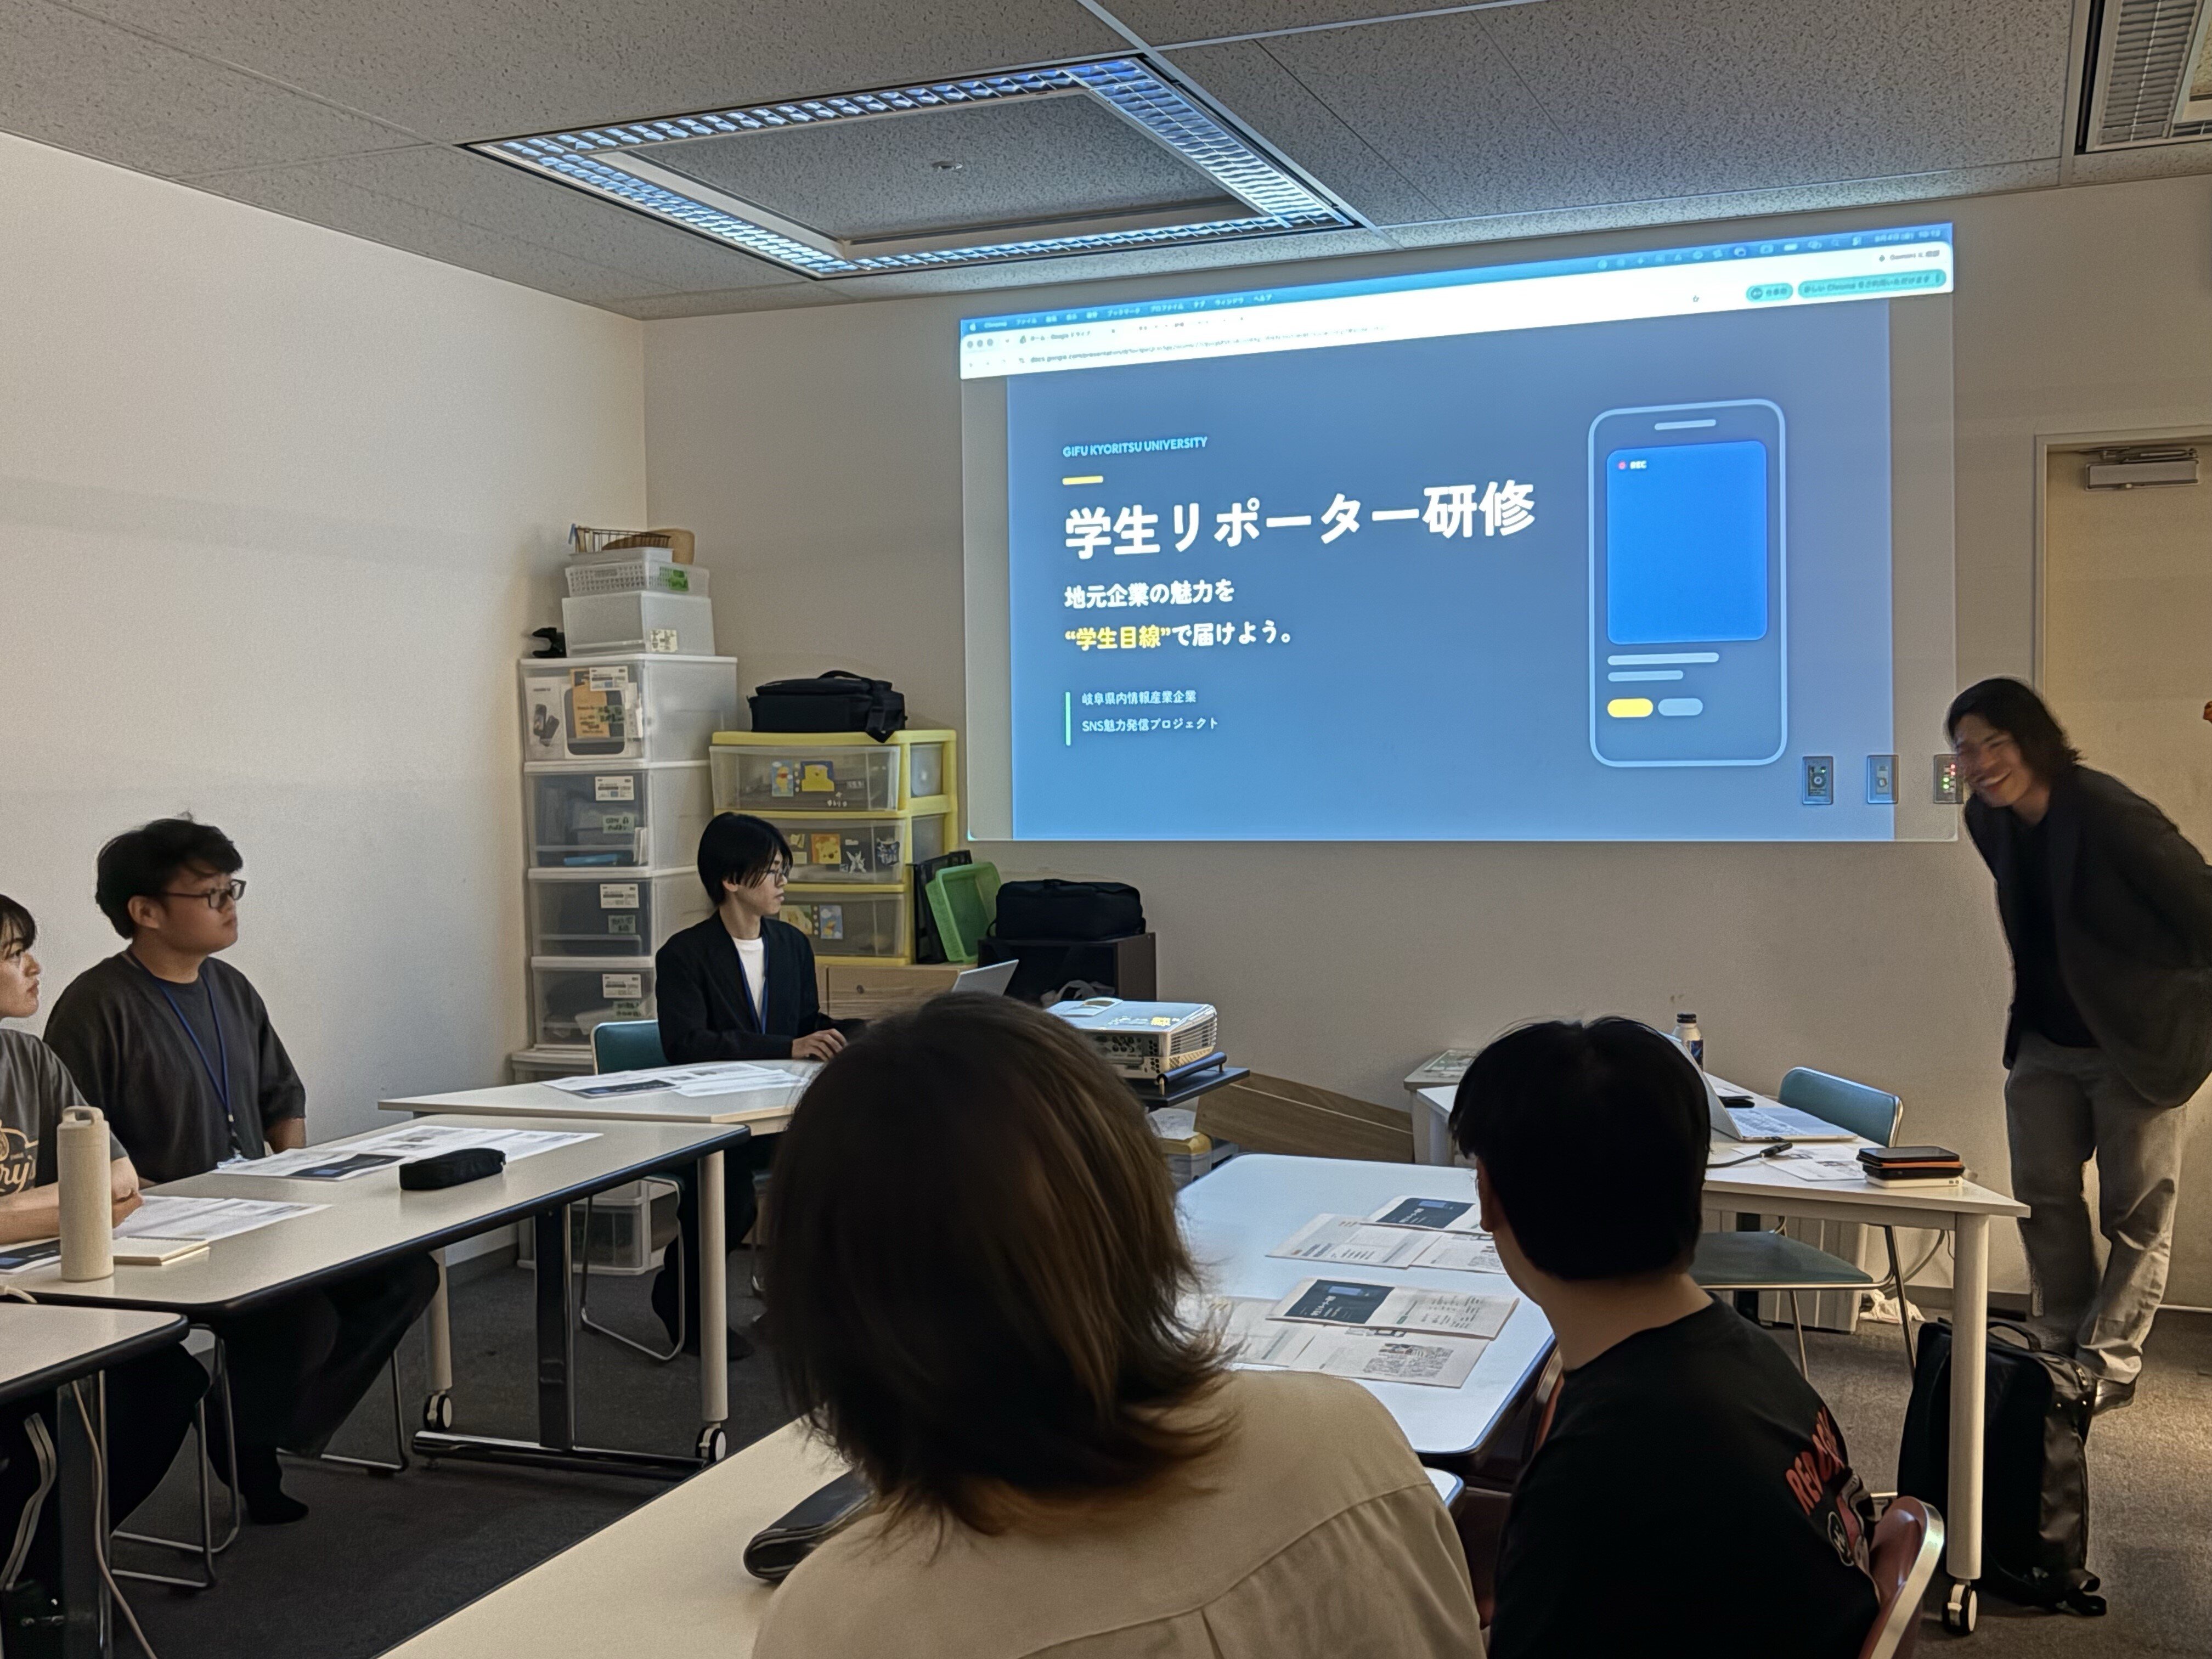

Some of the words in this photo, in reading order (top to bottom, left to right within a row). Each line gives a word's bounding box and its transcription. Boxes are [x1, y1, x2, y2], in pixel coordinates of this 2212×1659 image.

[1063, 445, 1088, 458] GIFU
[1090, 441, 1142, 455] KYORITSU
[1144, 436, 1207, 452] UNIVERSITY
[1630, 460, 1647, 470] REC
[1065, 479, 1536, 559] 学生リポーター研修
[1064, 578, 1234, 609] 地元企業の魅力を
[1082, 690, 1197, 706] 岐阜県内情報産業企業
[1082, 717, 1218, 732] SNS魅力発信プロジェクト
